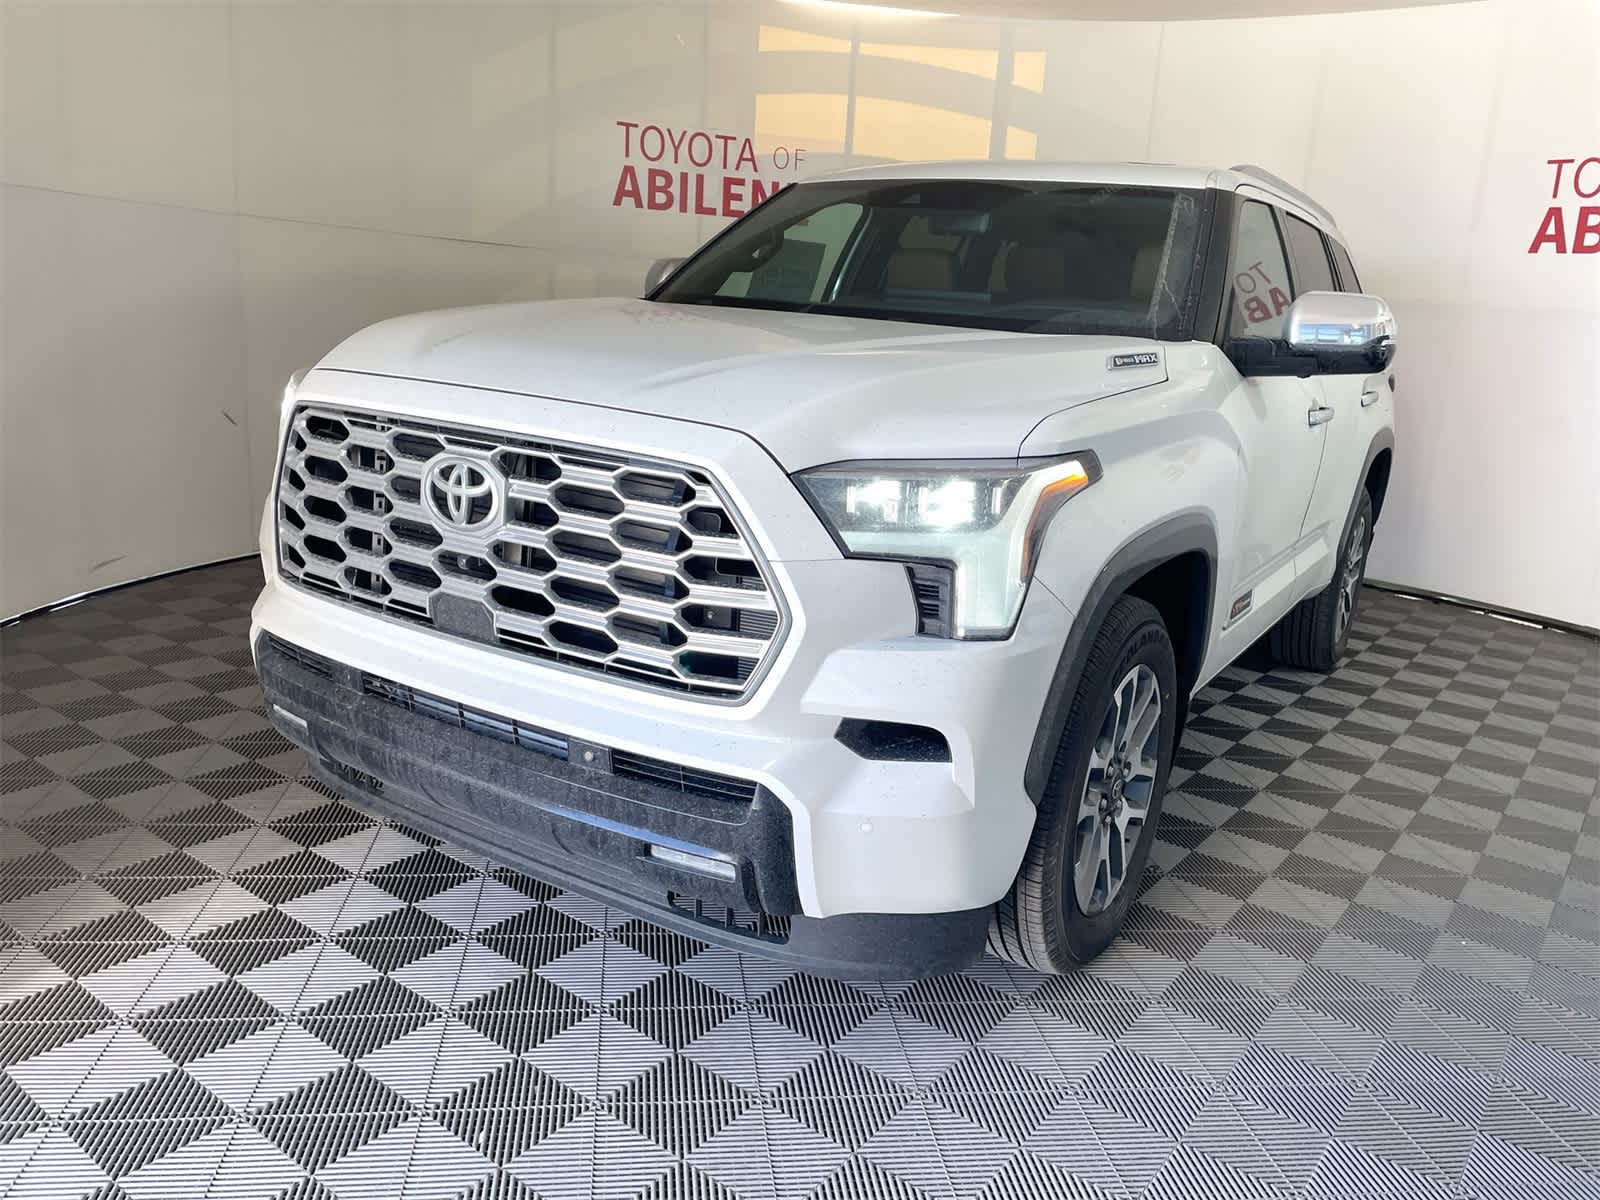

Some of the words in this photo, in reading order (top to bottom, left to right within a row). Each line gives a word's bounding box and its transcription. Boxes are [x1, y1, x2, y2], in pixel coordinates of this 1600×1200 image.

[616, 121, 759, 172] TOYOTA
[772, 147, 808, 171] OF
[1546, 157, 1600, 199] TO
[1528, 206, 1600, 254] AB
[1134, 353, 1158, 364] MAX
